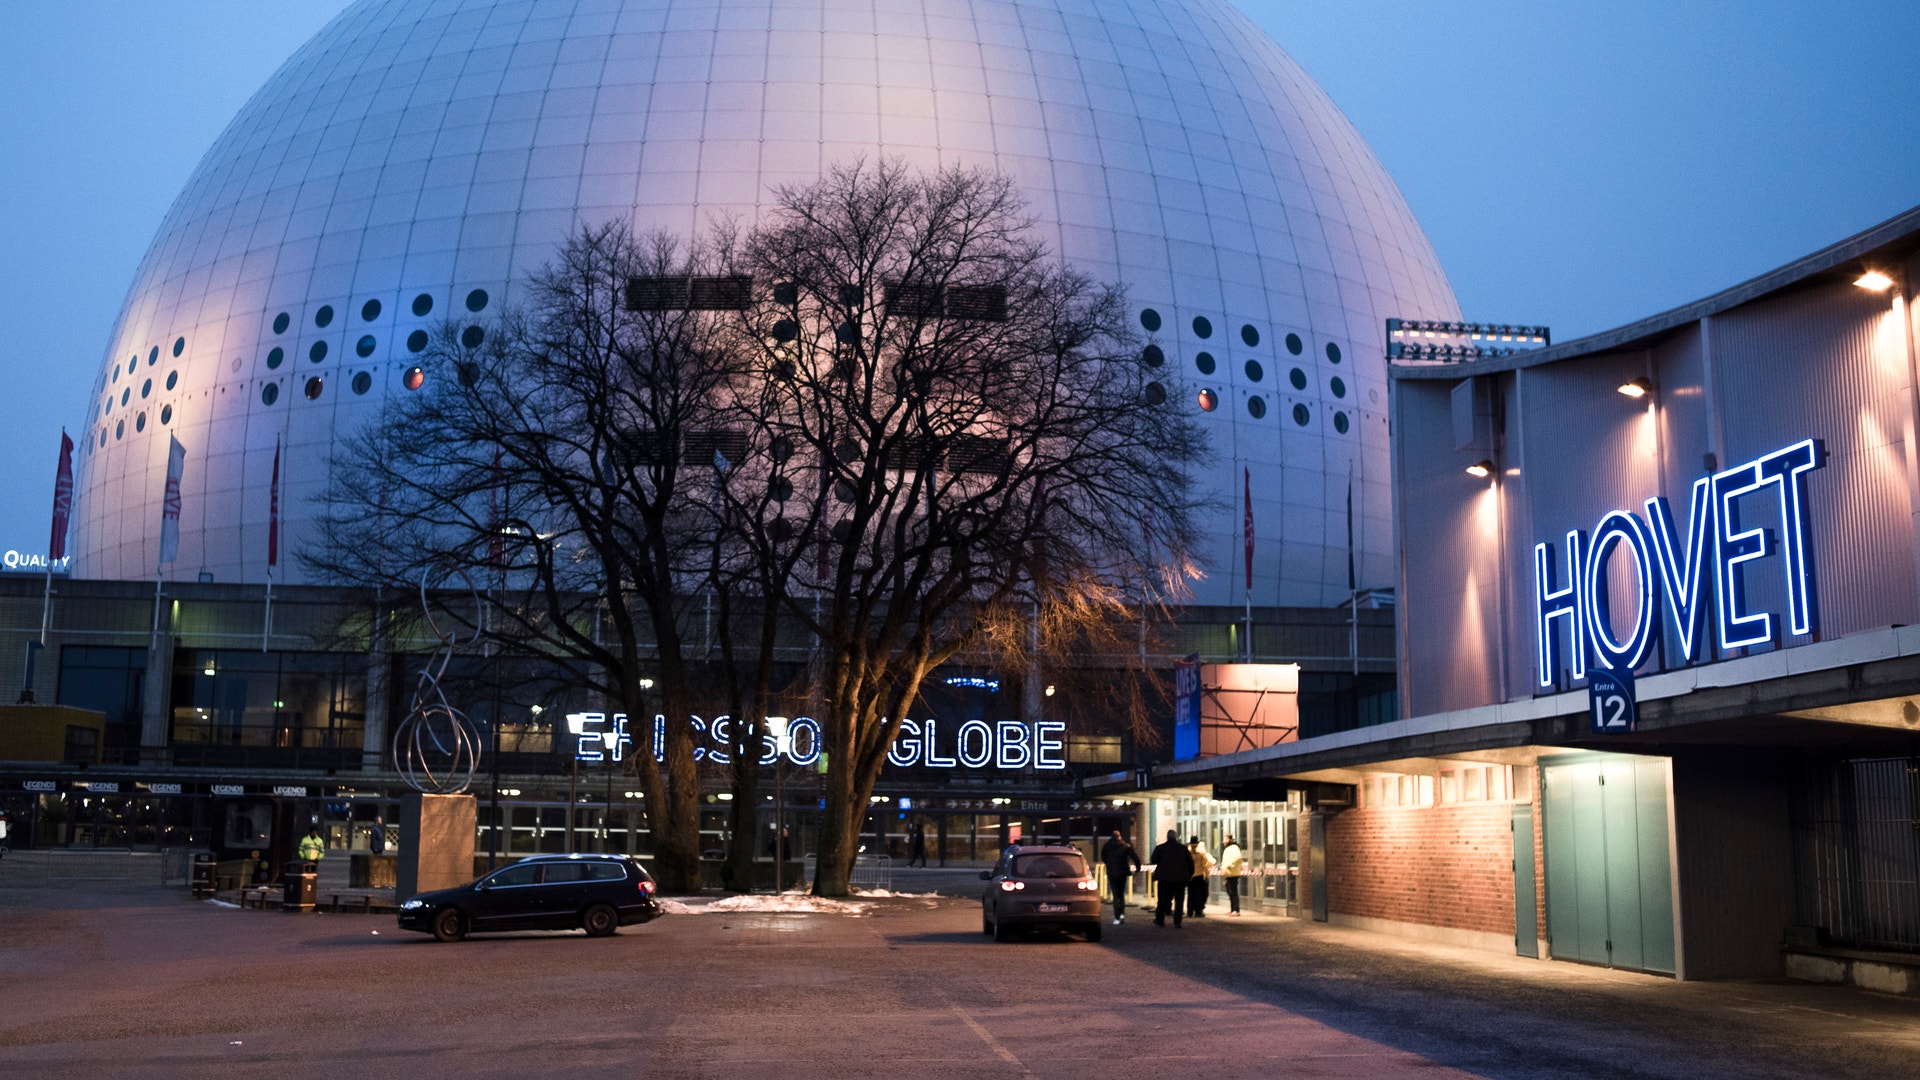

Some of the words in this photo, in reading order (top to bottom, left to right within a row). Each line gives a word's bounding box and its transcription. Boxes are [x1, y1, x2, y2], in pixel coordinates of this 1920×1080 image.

[4, 549, 70, 568] QUALY
[1535, 438, 1818, 687] HOVET
[1595, 683, 1615, 691] Entré
[1595, 695, 1626, 727] 12
[576, 712, 821, 765] ERISSO
[887, 718, 1066, 769] GLOBE
[23, 781, 56, 790] LEGENDS
[148, 783, 181, 794] LEGENDS
[211, 784, 244, 795] LEGENDS
[274, 786, 307, 797] LEGENDS
[1021, 800, 1048, 811] Entré
